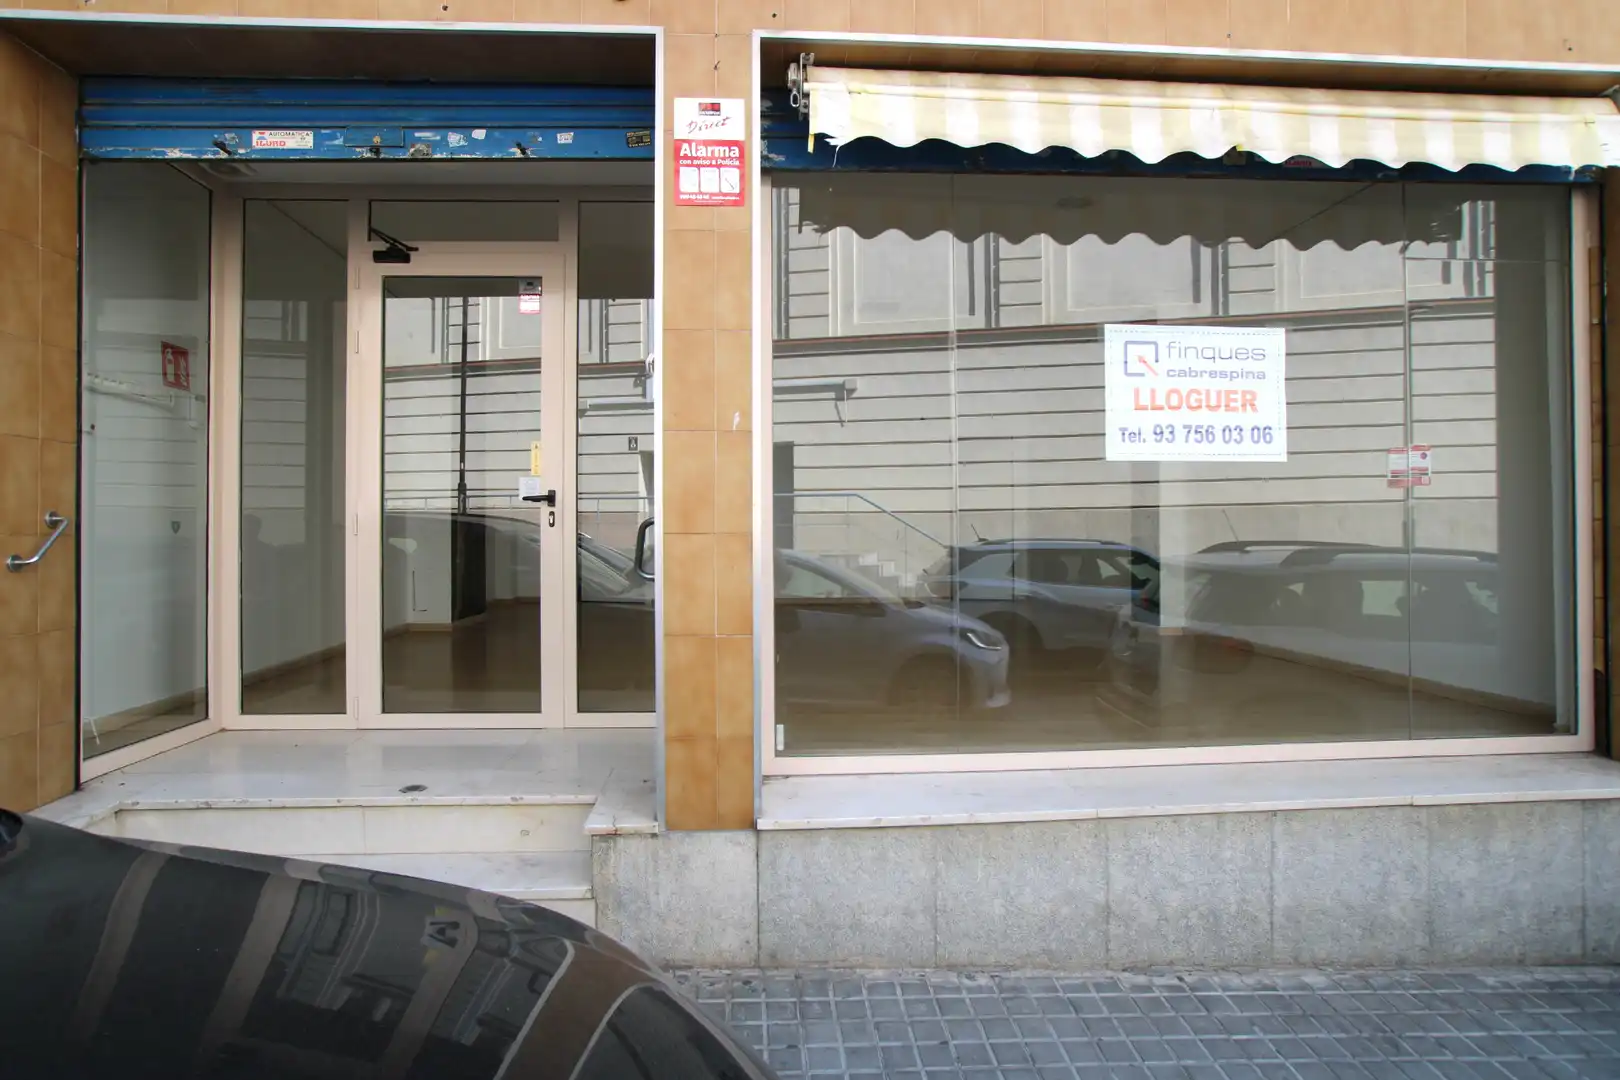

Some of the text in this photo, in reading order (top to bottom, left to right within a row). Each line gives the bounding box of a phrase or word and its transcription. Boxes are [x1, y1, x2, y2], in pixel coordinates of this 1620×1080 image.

[679, 142, 740, 157] Alarma
[1166, 341, 1267, 363] finques
[1166, 367, 1267, 381] cabrespina
[1133, 387, 1259, 413] LLOGUER
[1118, 424, 1274, 444] Tel. 93 756 03 06
